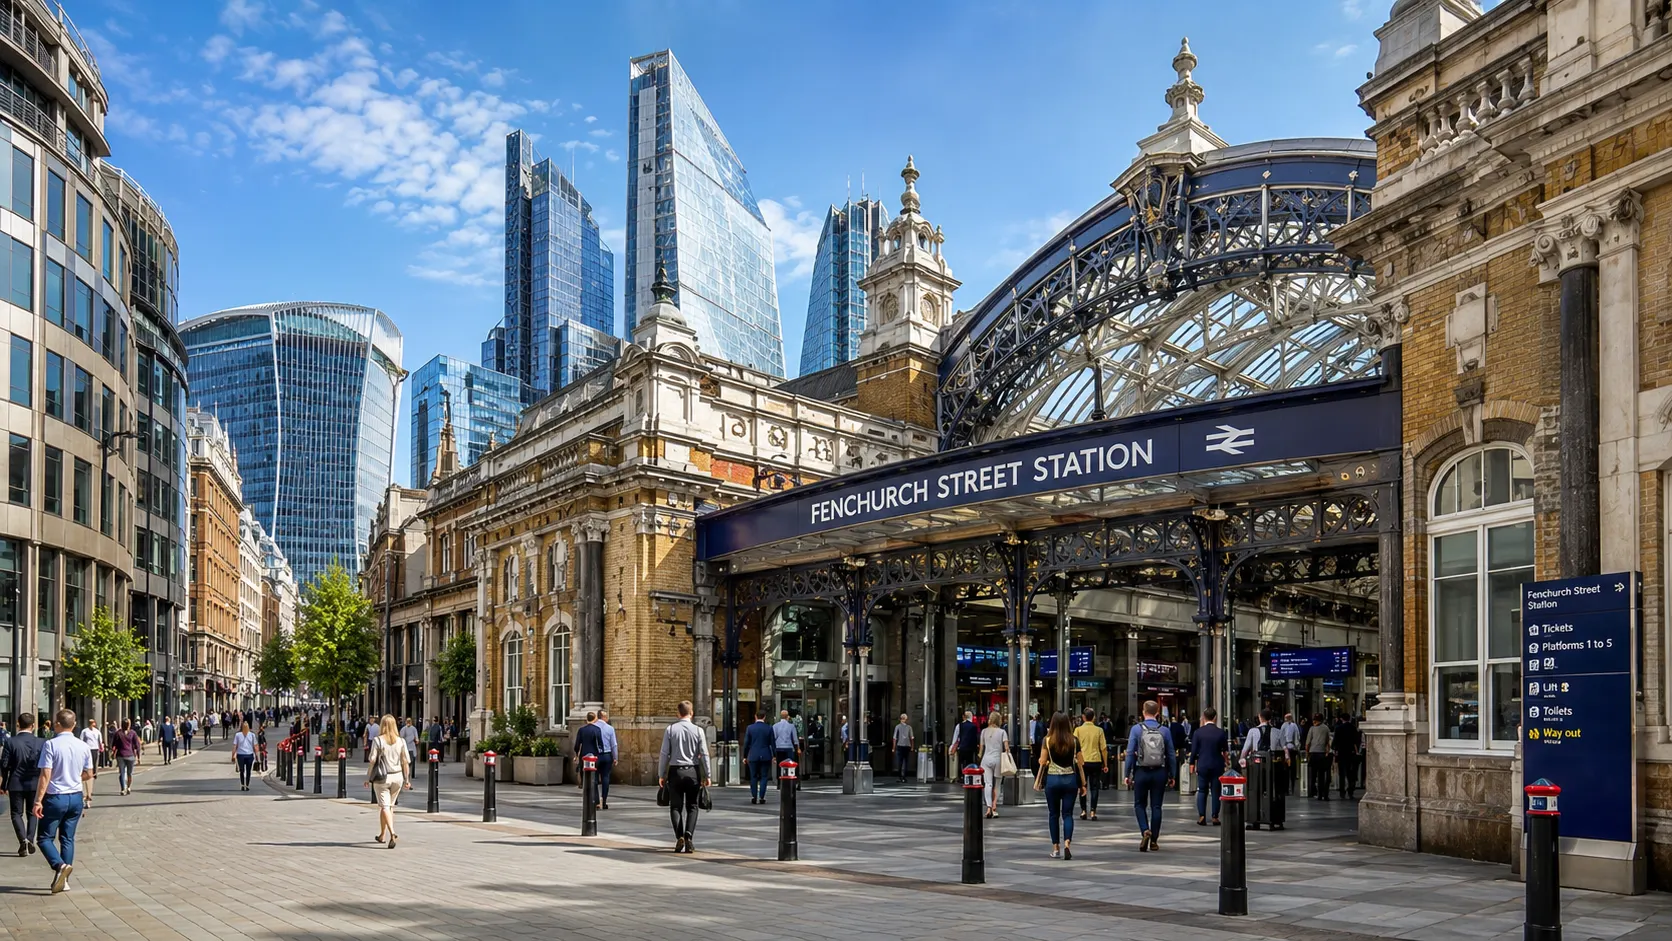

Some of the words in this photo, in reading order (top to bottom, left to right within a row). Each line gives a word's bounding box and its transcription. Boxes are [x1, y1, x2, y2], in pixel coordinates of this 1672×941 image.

[811, 479, 928, 524] FENCHURCH
[937, 461, 1023, 499] STREET
[1033, 438, 1153, 482] STATION
[1527, 587, 1572, 599] Fenchurch
[1573, 584, 1601, 595] Street
[1528, 601, 1558, 610] Station
[1542, 623, 1574, 633] Tickets
[1542, 640, 1584, 651] Platforms
[1586, 640, 1591, 648] 1
[1594, 640, 1604, 648] to
[1543, 706, 1573, 715] Toilets
[1543, 728, 1562, 739] Way
[1565, 729, 1582, 738] out
